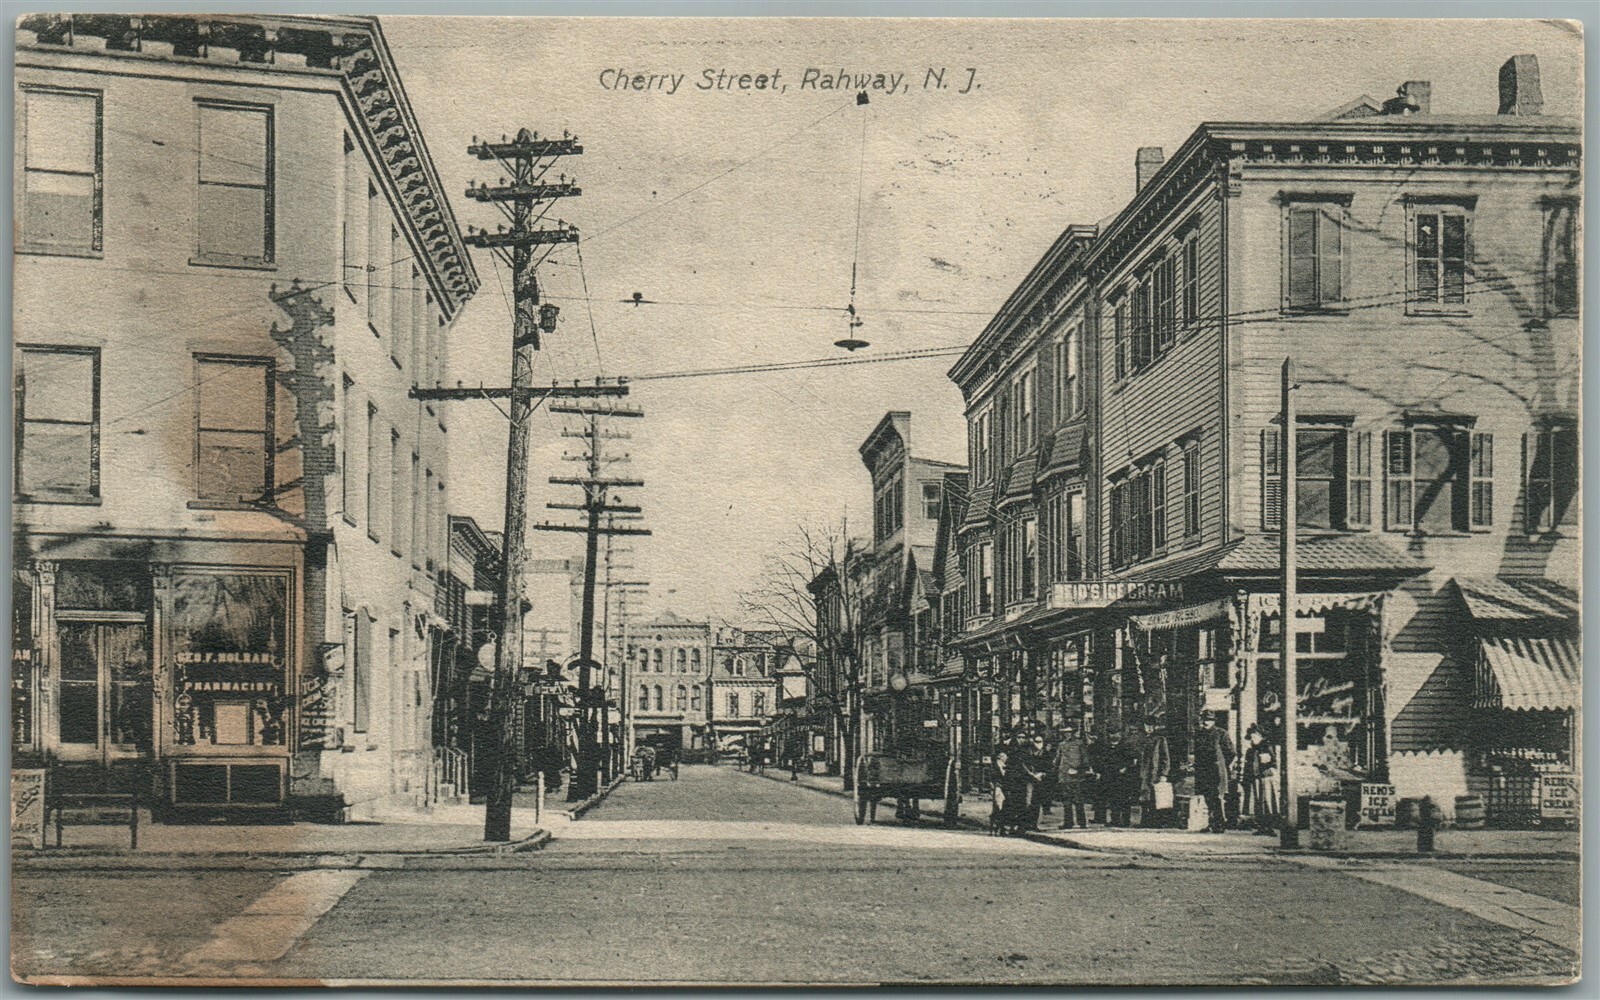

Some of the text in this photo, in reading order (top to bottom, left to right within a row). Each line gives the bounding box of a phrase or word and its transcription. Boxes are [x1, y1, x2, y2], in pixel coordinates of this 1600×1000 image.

[1102, 582, 1126, 601] ICE
[1127, 582, 1185, 601] CREAM
[184, 681, 273, 692] PHARMACIST
[1549, 788, 1568, 799] ICE
[1368, 796, 1389, 807] ICE
